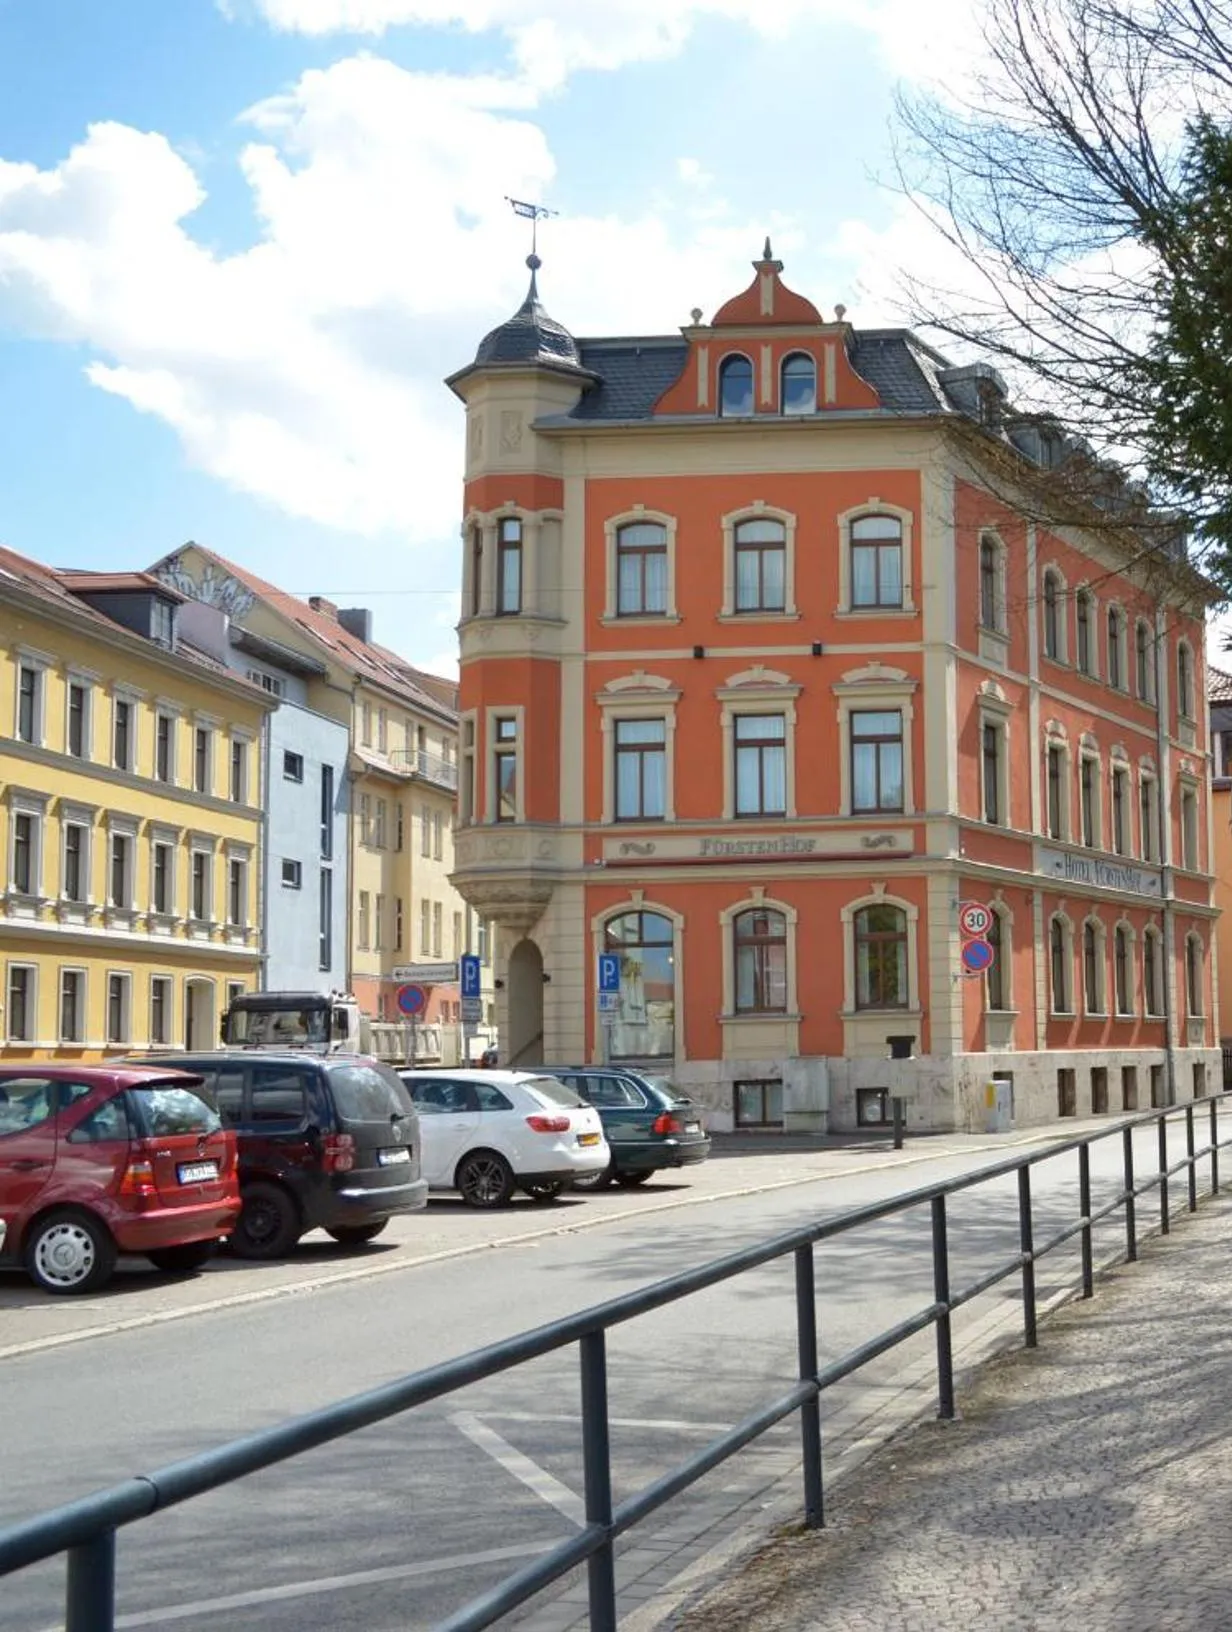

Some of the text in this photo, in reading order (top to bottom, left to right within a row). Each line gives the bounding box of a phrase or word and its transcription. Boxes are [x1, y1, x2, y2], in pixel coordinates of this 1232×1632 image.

[967, 912, 985, 928] 30
[465, 961, 476, 992] P
[603, 959, 615, 987] P
